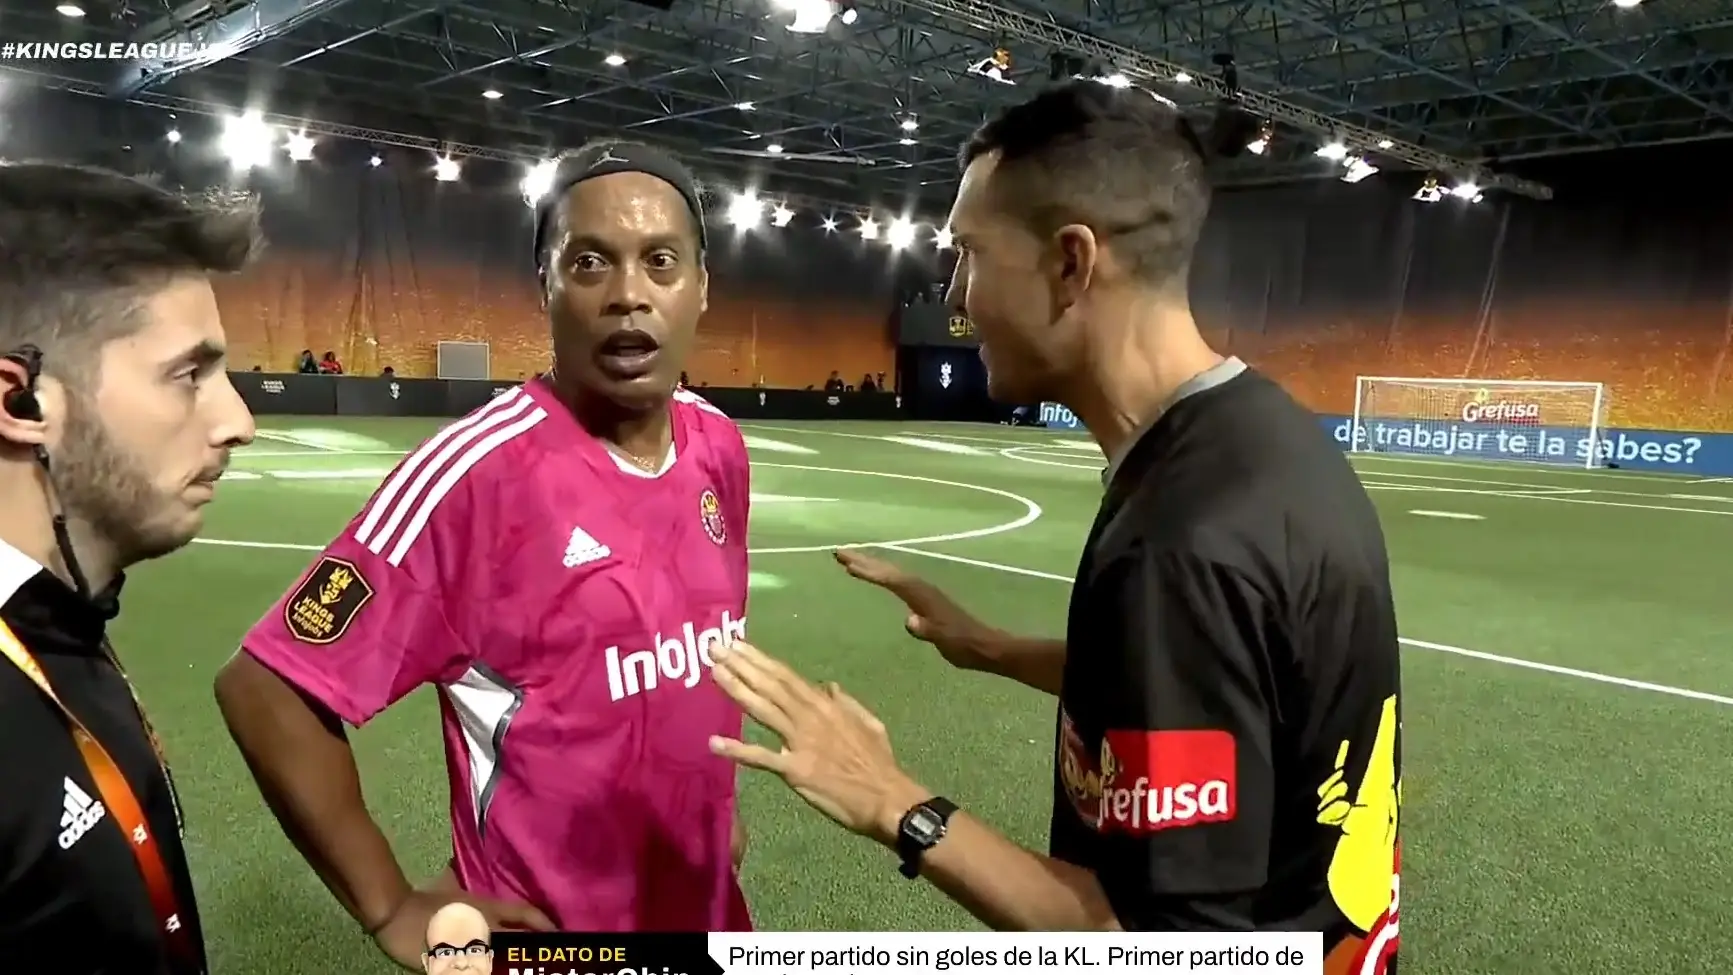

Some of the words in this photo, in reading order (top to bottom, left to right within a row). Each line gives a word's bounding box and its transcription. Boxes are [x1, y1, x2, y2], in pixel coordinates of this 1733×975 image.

[1463, 400, 1539, 422] Grefusa
[1334, 419, 1367, 443] de
[1375, 423, 1488, 454] trabajar
[1499, 428, 1527, 453] te
[1539, 430, 1565, 456] la
[1576, 433, 1702, 464] sabes?
[294, 601, 334, 633] LEAGUE
[302, 596, 335, 622] KINGS
[1097, 776, 1229, 829] refusa
